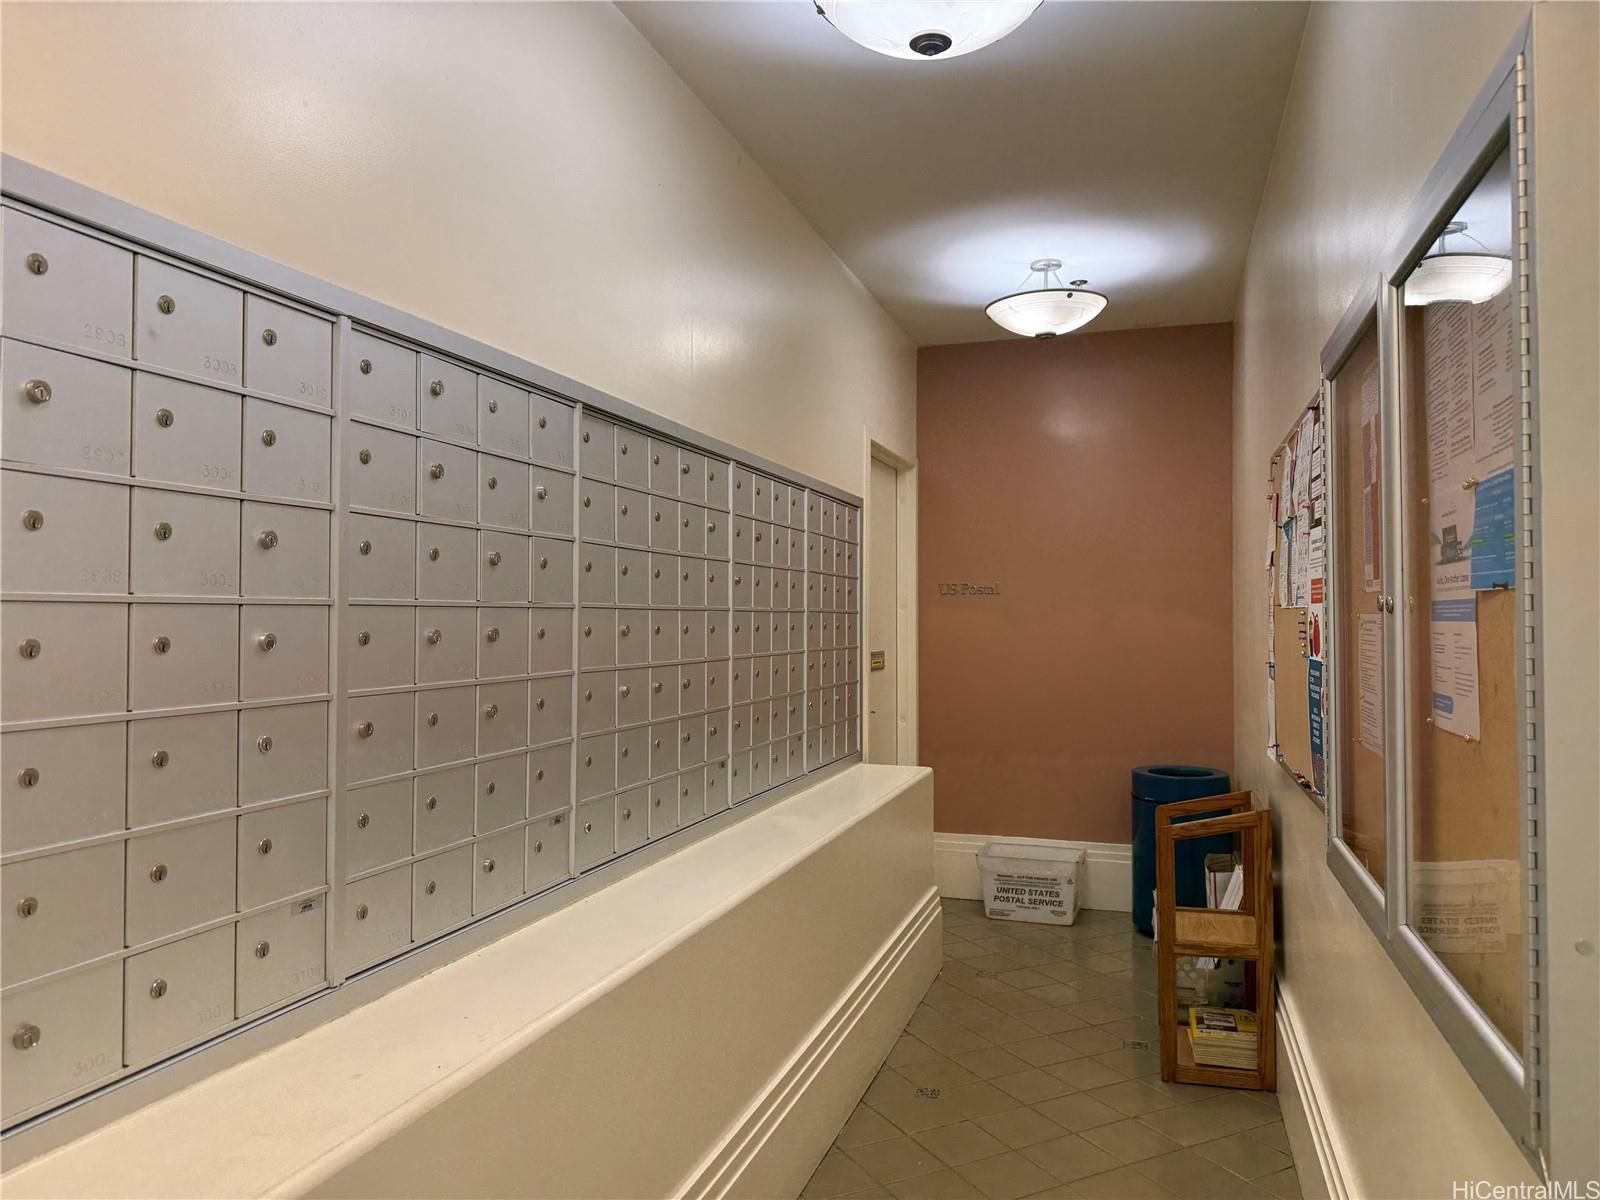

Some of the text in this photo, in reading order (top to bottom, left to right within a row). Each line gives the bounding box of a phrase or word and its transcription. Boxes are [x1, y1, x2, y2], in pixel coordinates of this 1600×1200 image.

[937, 583, 1001, 596] US Postal
[996, 886, 1060, 899] UNITED STATES
[993, 895, 1026, 905] POSTAL
[1027, 898, 1064, 908] SERVICE
